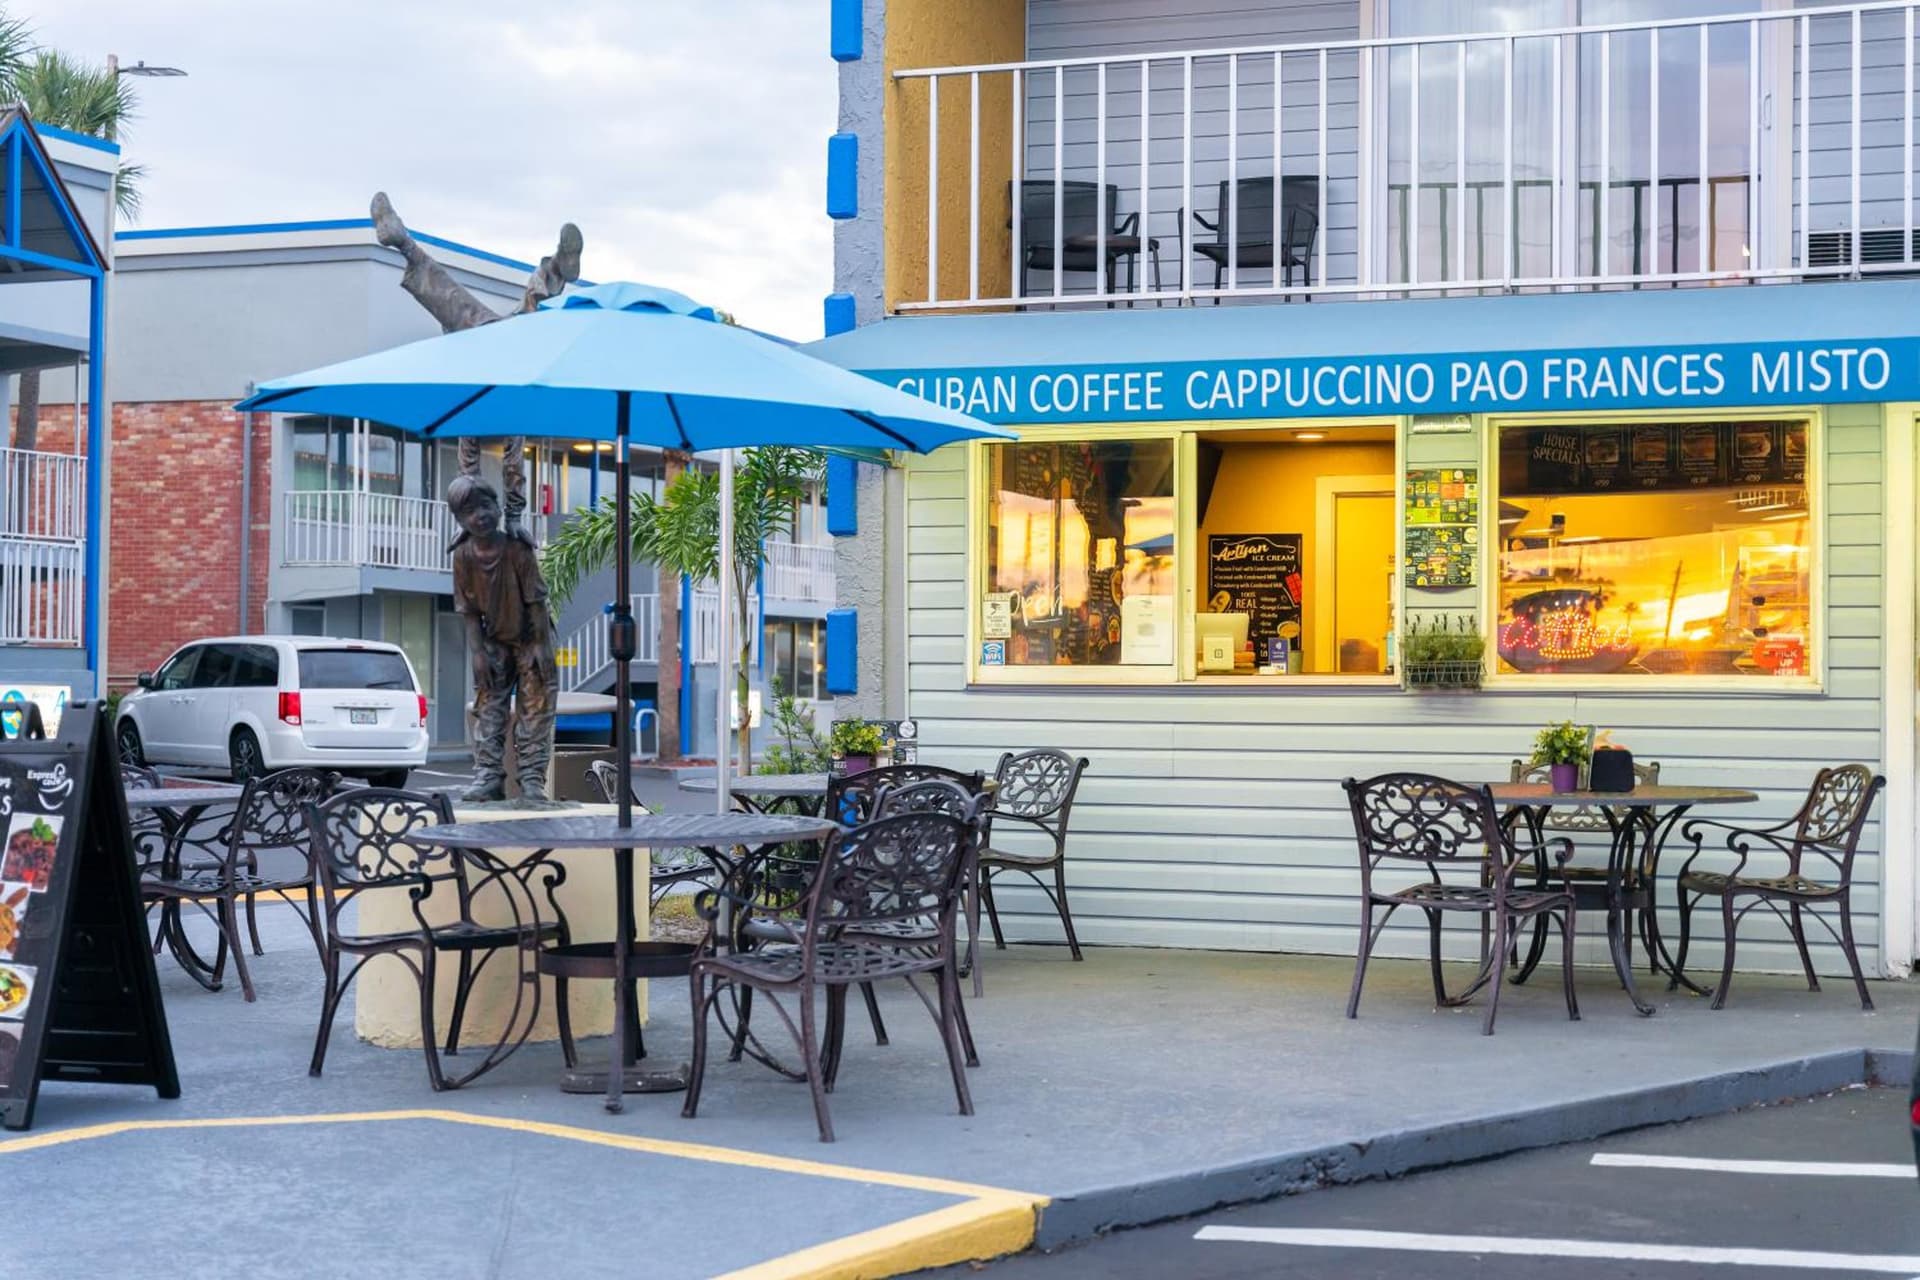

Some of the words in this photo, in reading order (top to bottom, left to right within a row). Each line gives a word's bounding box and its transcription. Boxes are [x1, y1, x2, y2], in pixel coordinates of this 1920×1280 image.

[1029, 371, 1164, 413] COFFEE
[1185, 362, 1435, 409] CAPPUCCINO
[1450, 359, 1529, 402] PAO
[1542, 353, 1726, 399] FRANCES
[1750, 347, 1891, 394] MISTO
[1543, 432, 1577, 449] HOUSE
[1532, 446, 1581, 465] SPECIALS
[1217, 543, 1269, 561] Artisan
[1235, 599, 1257, 609] REAL
[1780, 659, 1793, 667] UP
